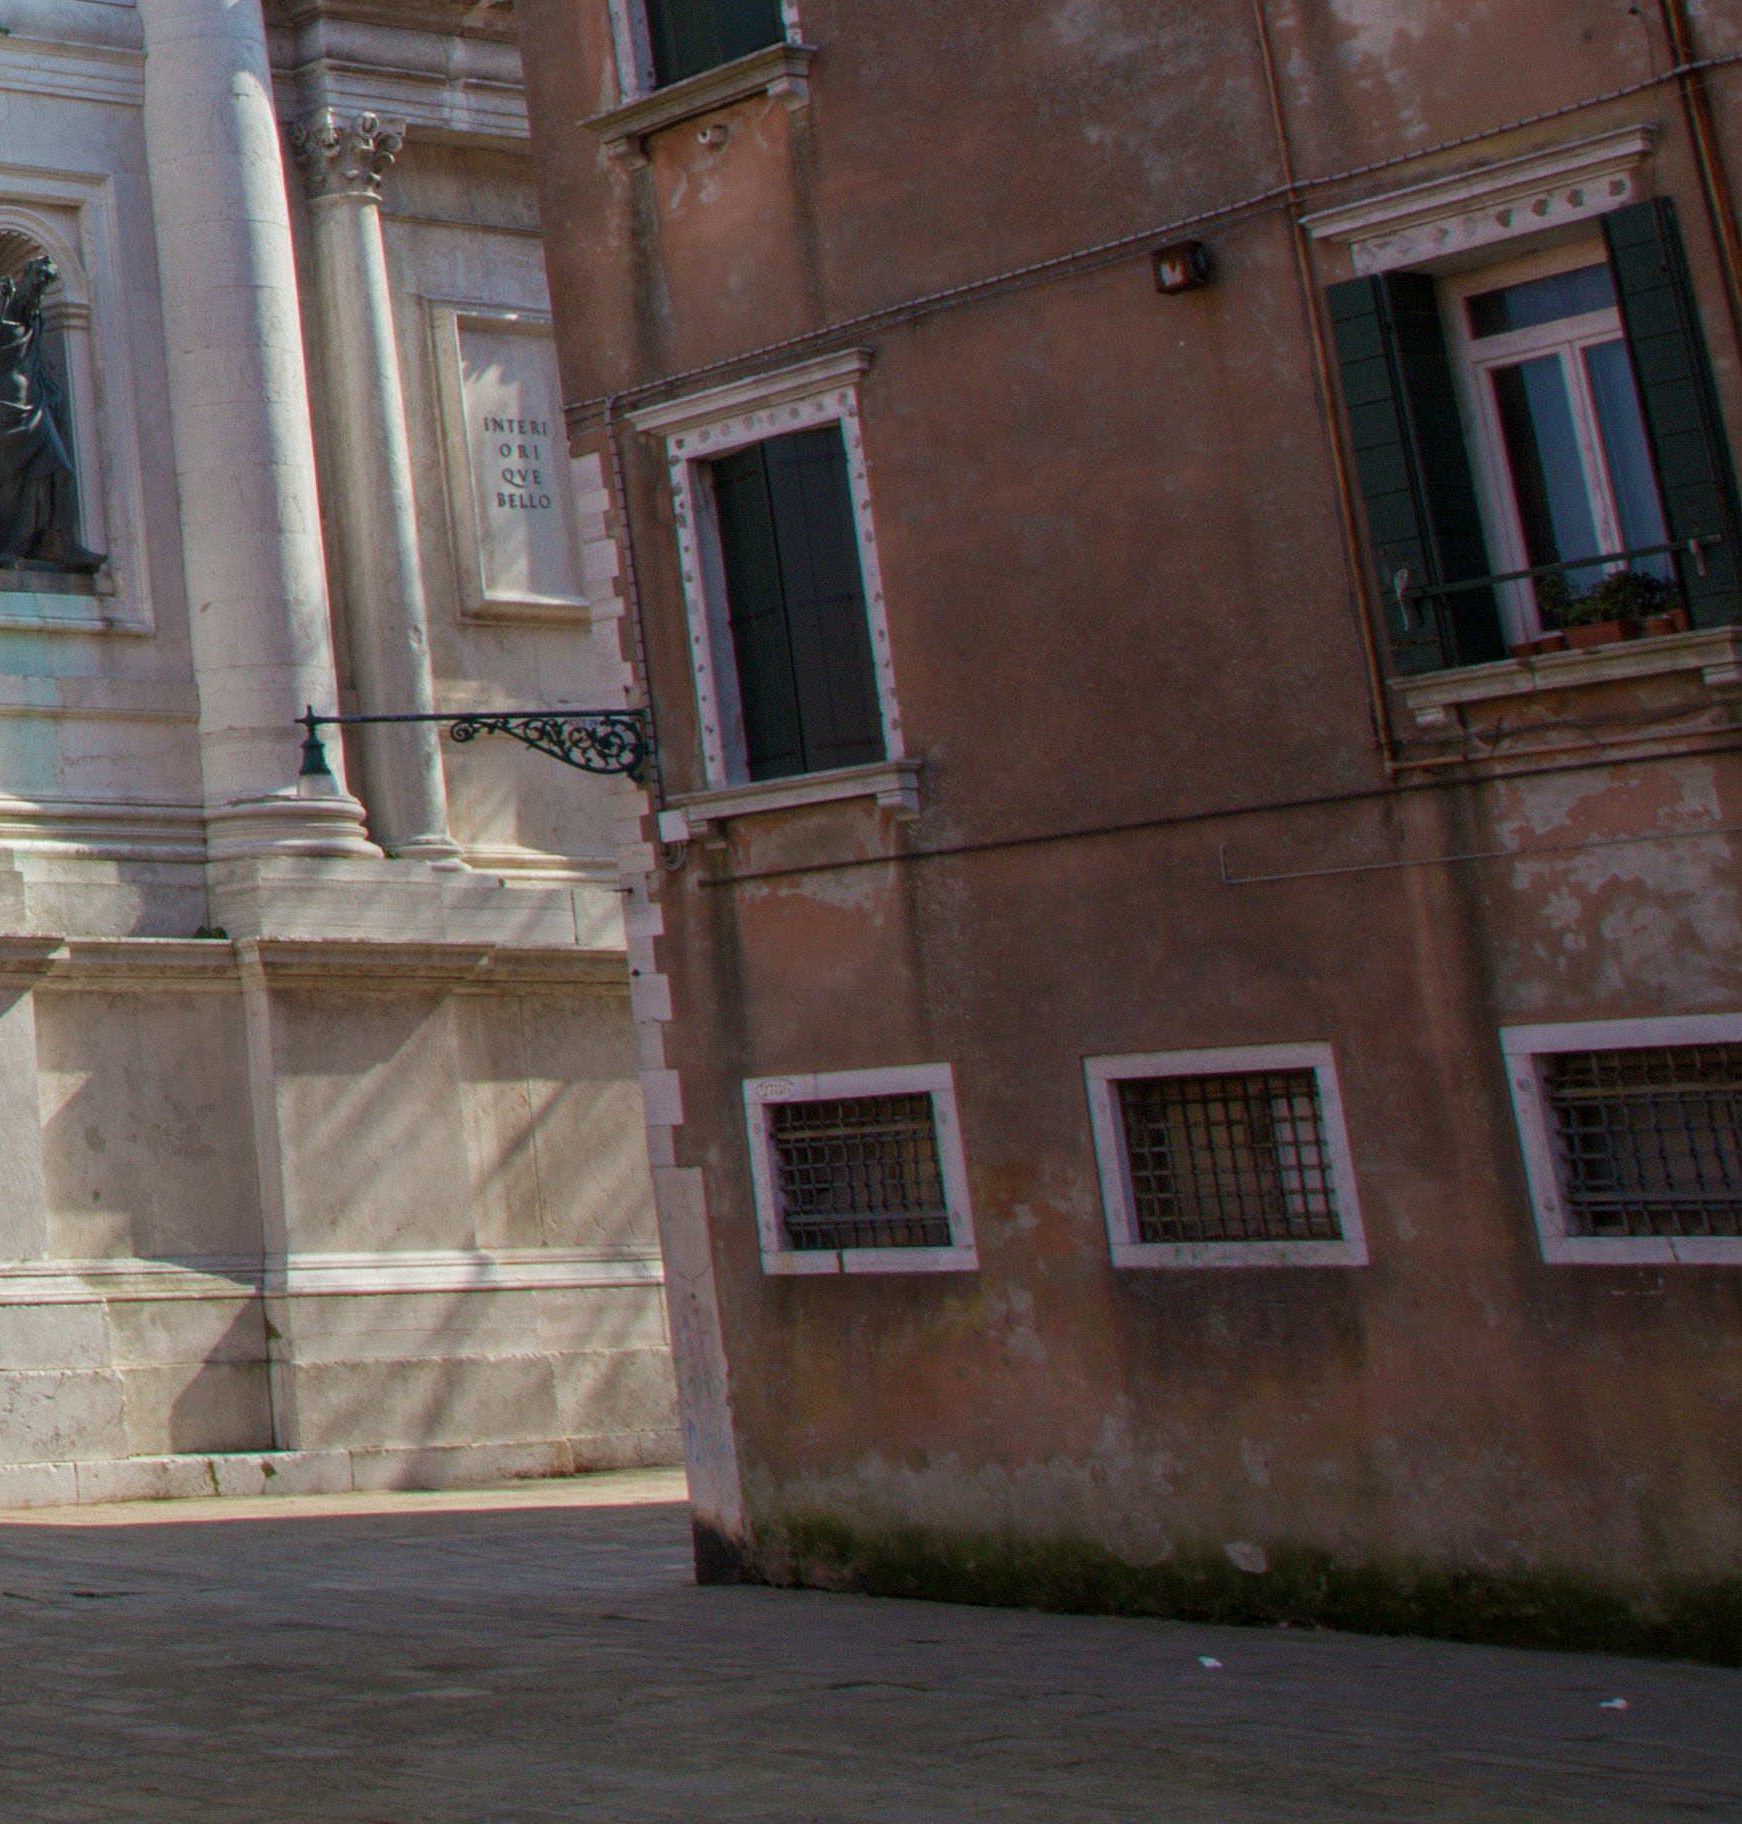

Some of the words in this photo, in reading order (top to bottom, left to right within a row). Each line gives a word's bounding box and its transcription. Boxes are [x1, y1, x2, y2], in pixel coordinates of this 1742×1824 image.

[484, 417, 547, 436] INTERI
[499, 443, 539, 460] ORI
[502, 468, 542, 488] QVE
[497, 492, 551, 509] BELLO
